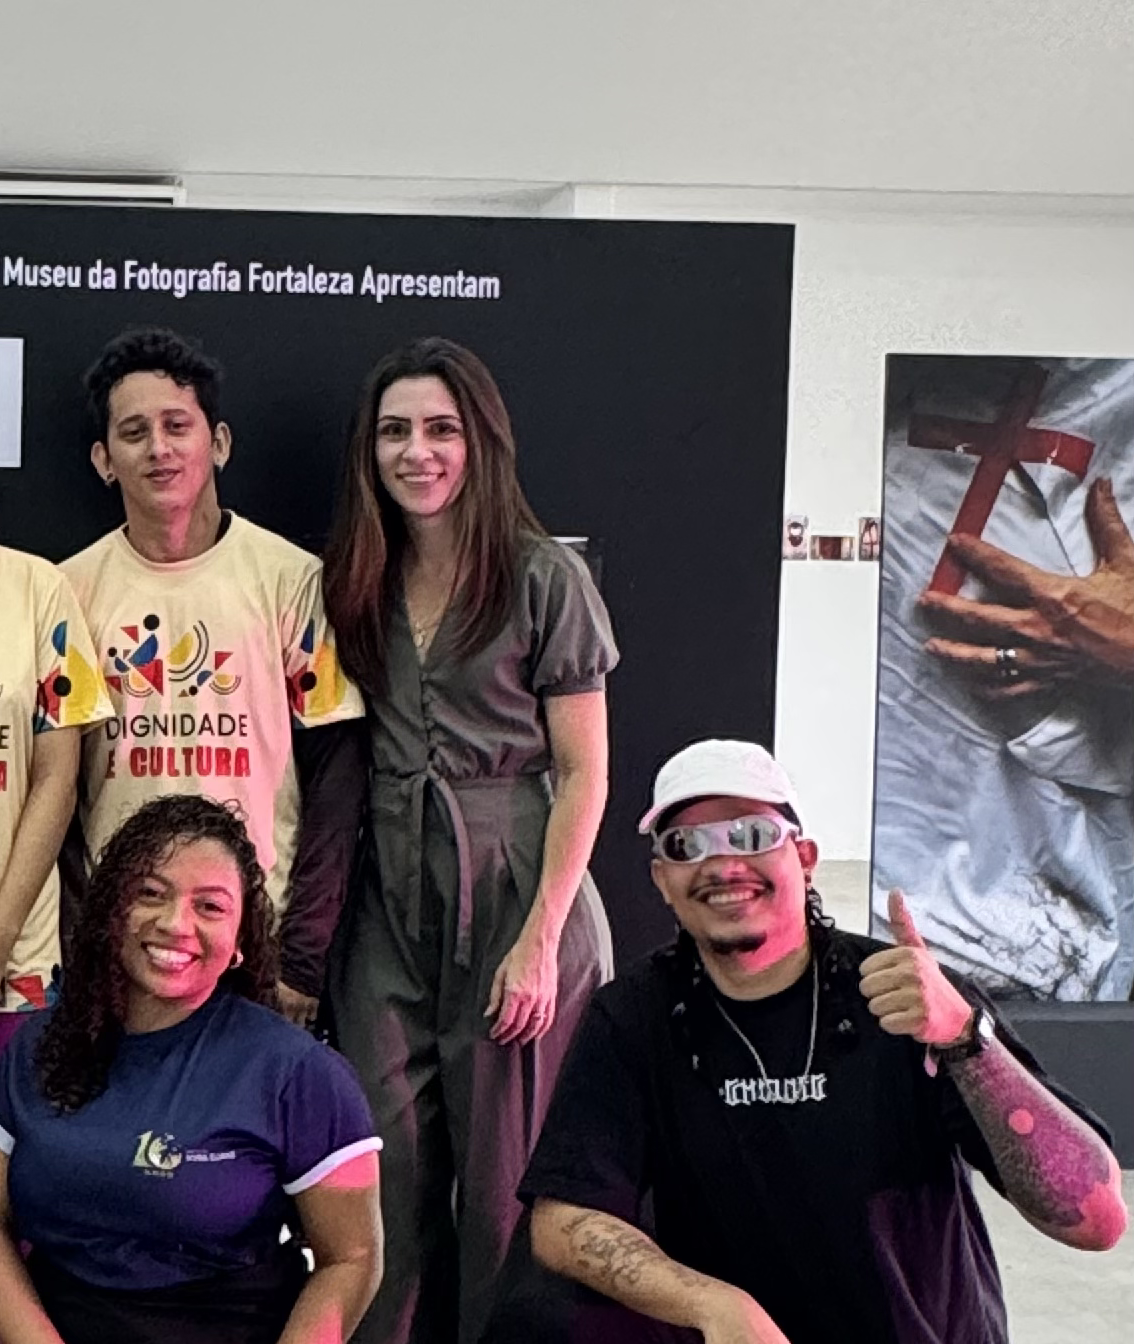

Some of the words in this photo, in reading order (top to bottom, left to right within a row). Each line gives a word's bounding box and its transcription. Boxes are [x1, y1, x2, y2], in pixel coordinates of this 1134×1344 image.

[2, 256, 81, 289] Museu
[88, 259, 117, 290] da
[123, 260, 242, 299] Fotografia
[248, 262, 354, 295] Fortaleza
[360, 265, 501, 304] Apresentam
[105, 712, 248, 740] DIGNIDADE
[129, 745, 252, 778] CULTURA
